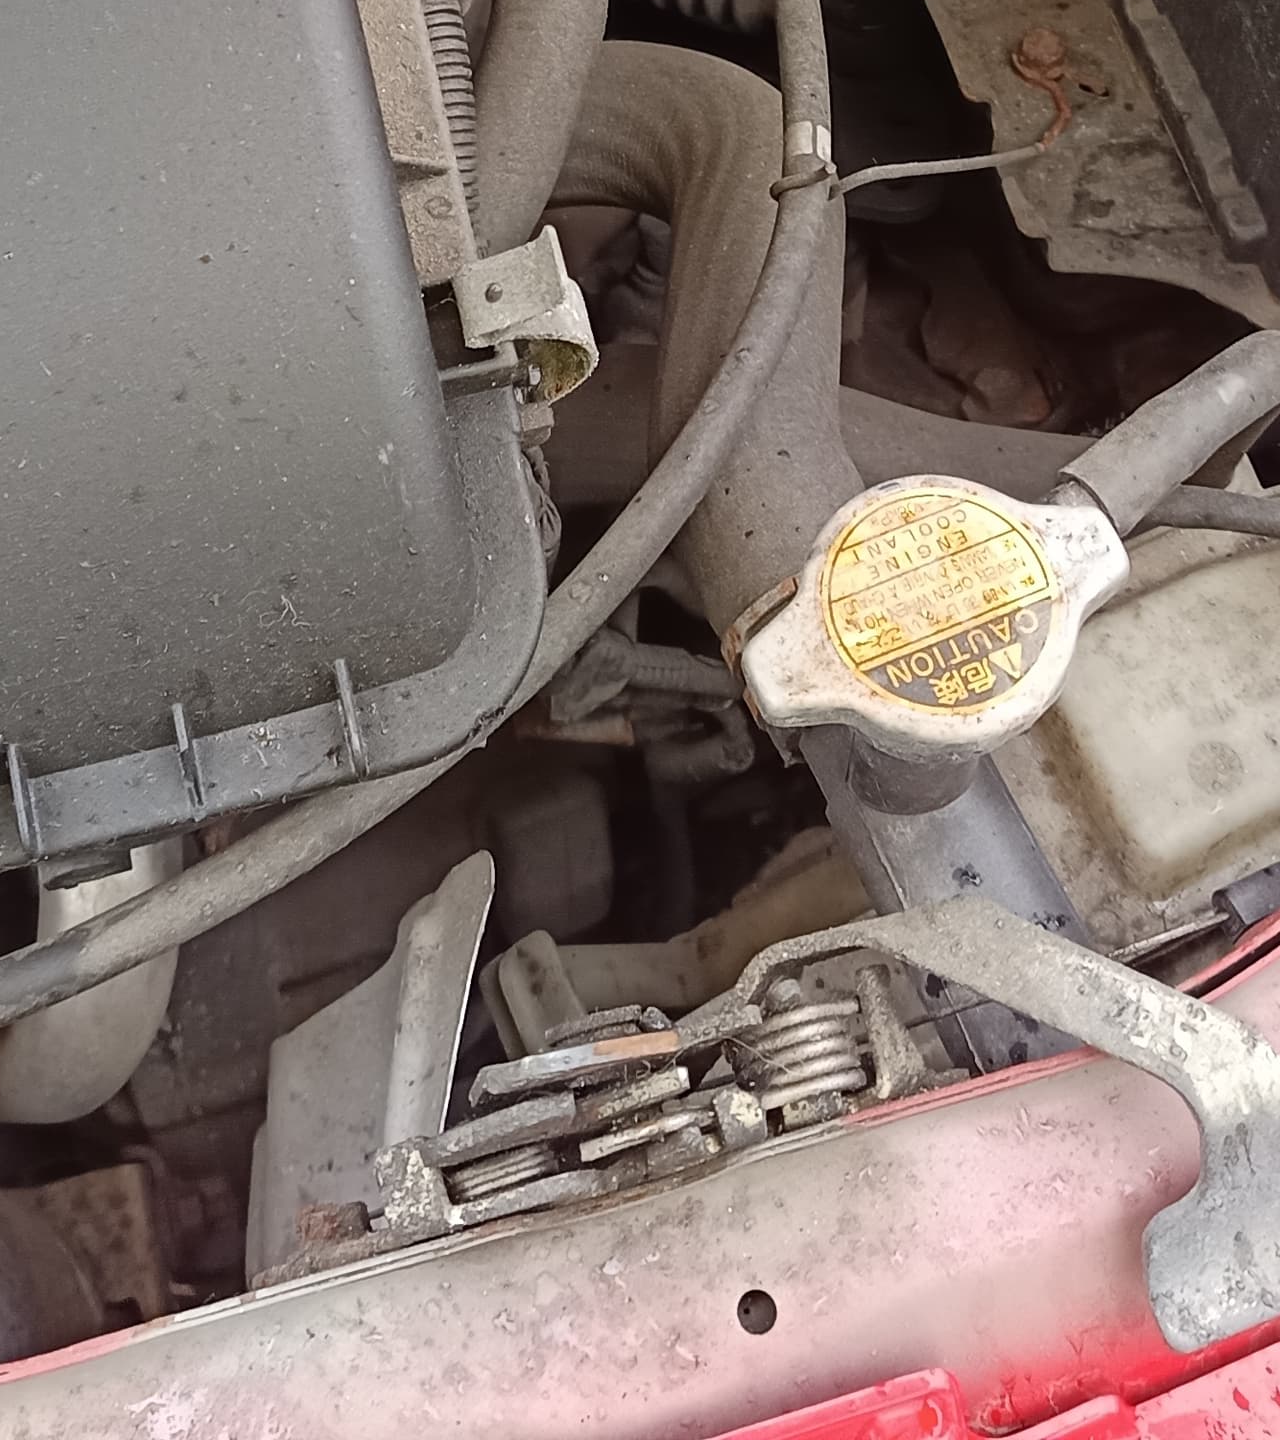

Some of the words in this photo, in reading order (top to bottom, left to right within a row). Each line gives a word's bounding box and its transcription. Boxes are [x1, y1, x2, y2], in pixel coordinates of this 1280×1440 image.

[851, 508, 968, 562] COOLANT
[867, 529, 969, 581] ENGINE
[974, 555, 1028, 580] NEVER
[886, 593, 933, 619] WHEN
[932, 575, 975, 602] OPEN
[854, 610, 888, 635] HOT
[885, 608, 1040, 689] CAUTION
[928, 657, 998, 706] 危険
